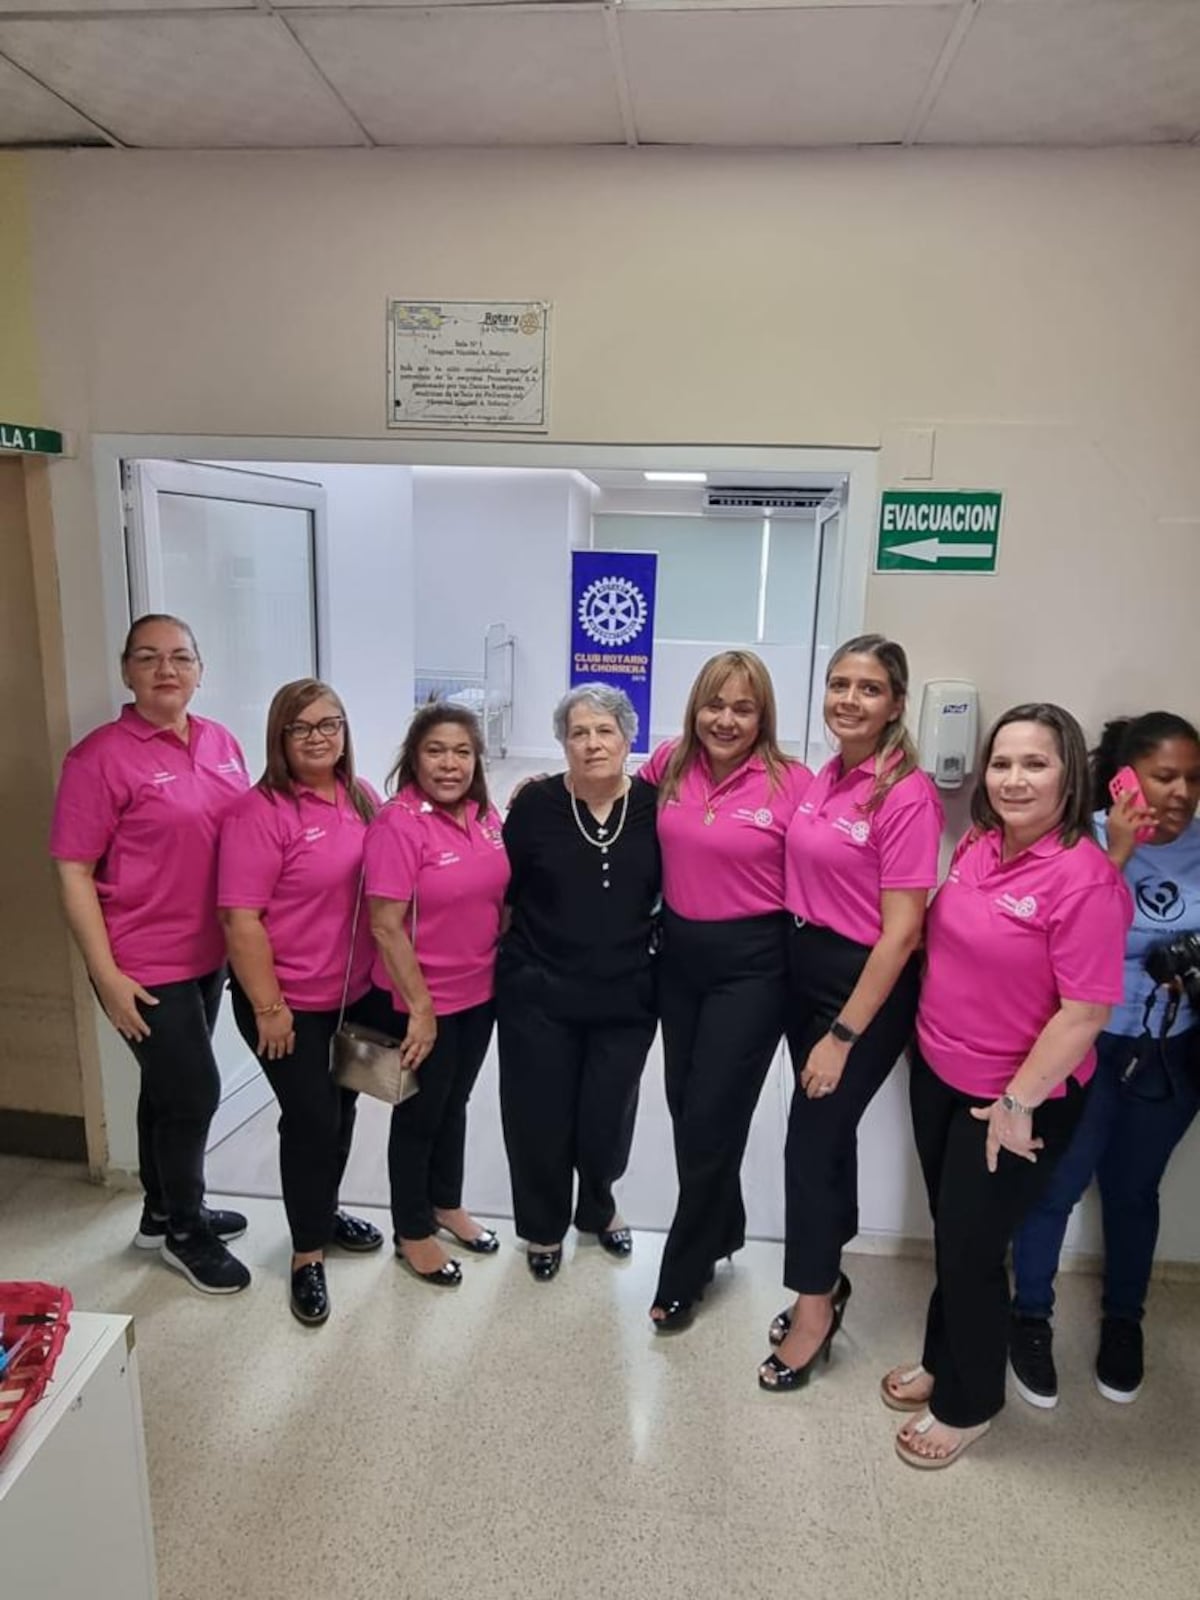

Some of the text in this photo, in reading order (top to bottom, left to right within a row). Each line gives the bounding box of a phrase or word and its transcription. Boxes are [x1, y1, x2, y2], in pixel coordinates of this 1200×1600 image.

[485, 312, 519, 326] Rotary
[28, 431, 36, 450] 1
[883, 504, 998, 532] EVACUACION
[574, 652, 648, 665] CLUB ROTARIO
[575, 663, 646, 674] LA CHORRERA
